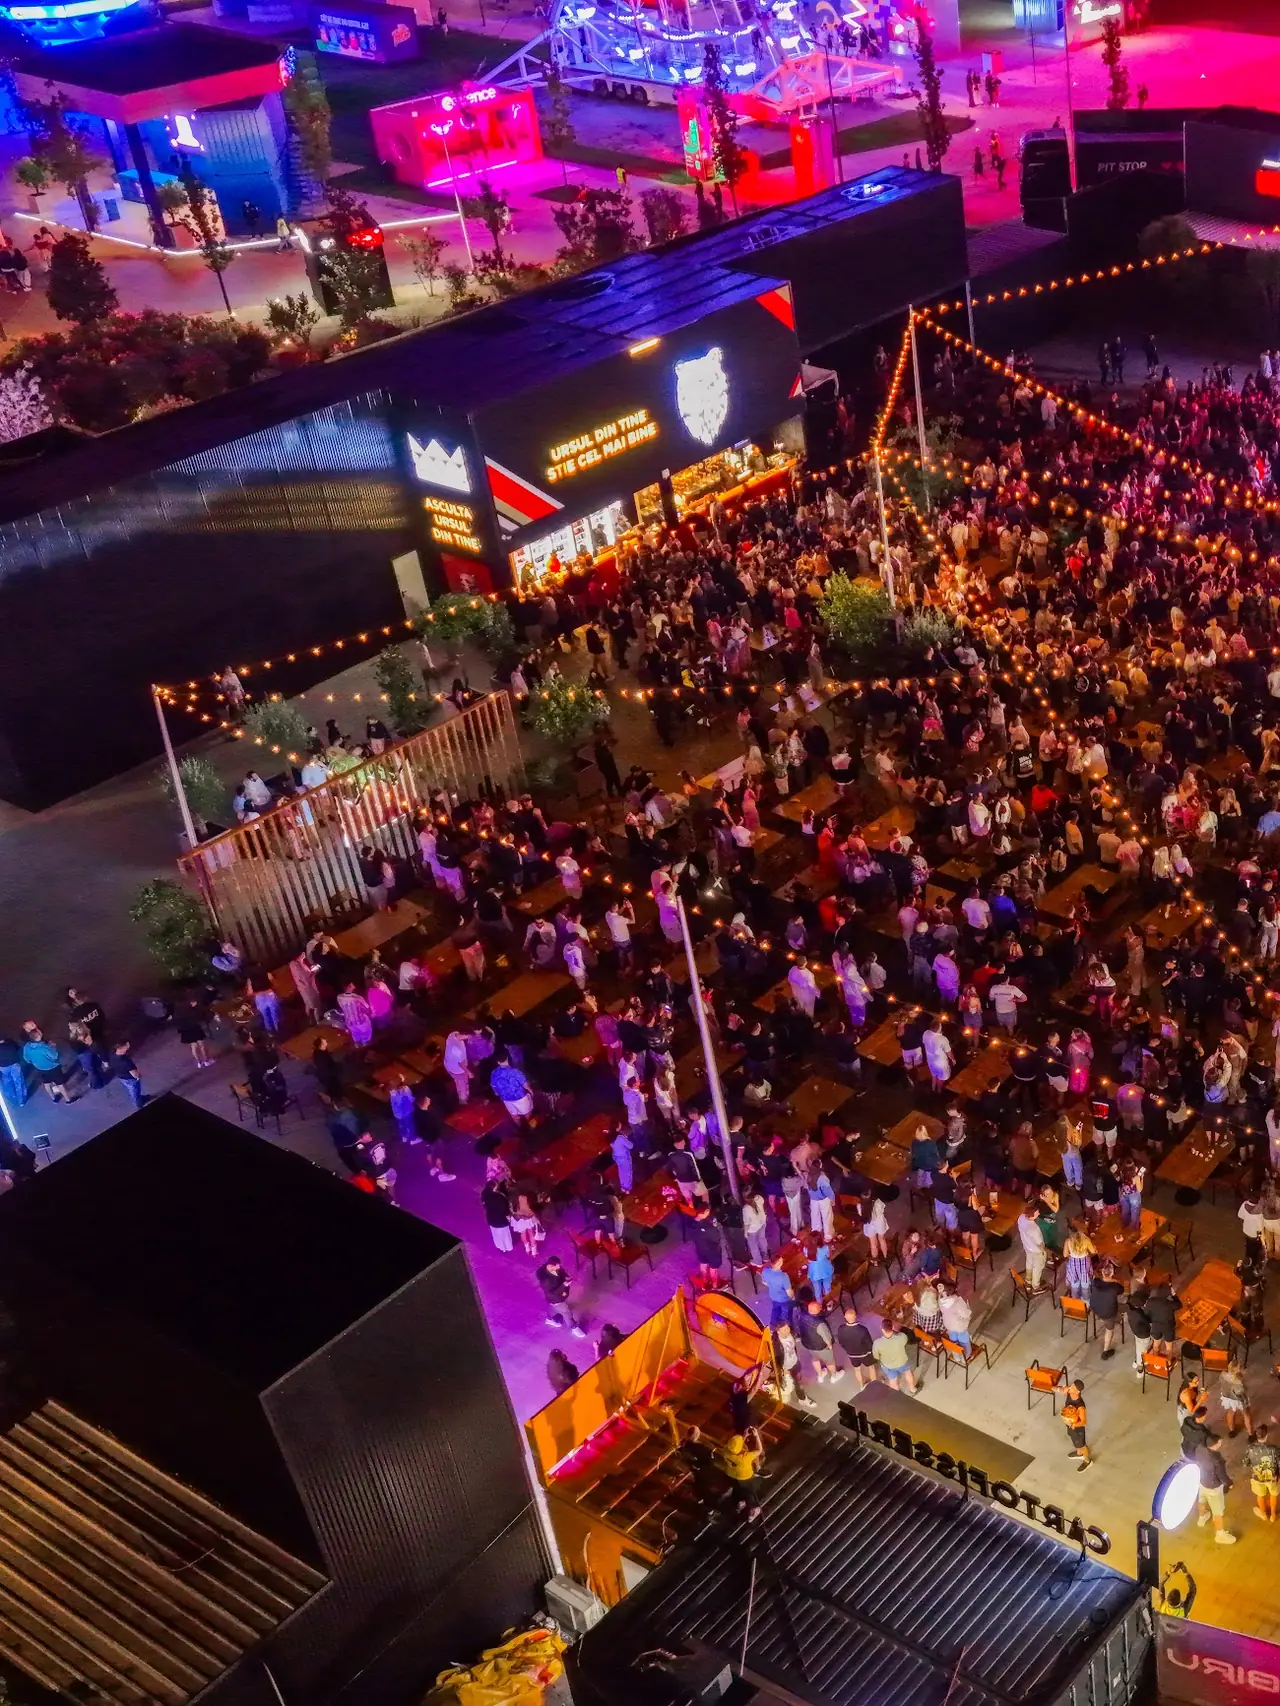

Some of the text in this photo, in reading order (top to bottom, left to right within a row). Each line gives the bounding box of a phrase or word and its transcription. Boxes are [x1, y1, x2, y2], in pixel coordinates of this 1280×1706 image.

[1097, 161, 1148, 173] PIT STOP
[550, 409, 649, 462] URSUL DIN TINE
[547, 422, 659, 483] STIE CEL MAI BINE
[424, 497, 473, 521] ASCULTA
[433, 513, 472, 534] URSUL
[431, 527, 452, 545] DIN
